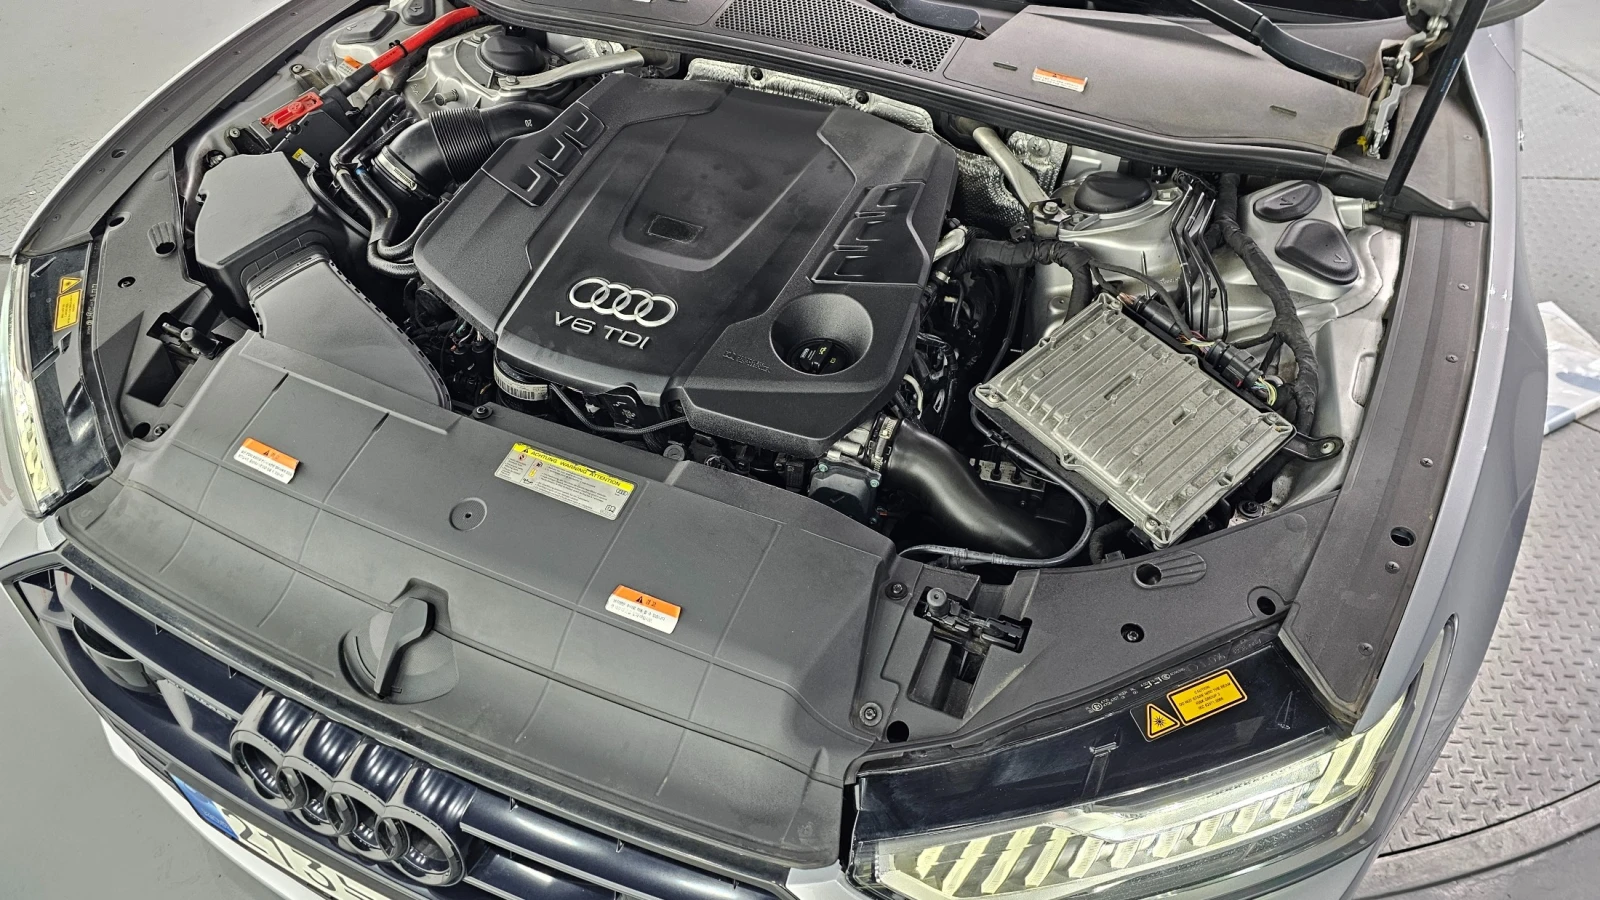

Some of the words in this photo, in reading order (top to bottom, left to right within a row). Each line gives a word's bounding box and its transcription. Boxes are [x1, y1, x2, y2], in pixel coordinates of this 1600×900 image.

[555, 311, 596, 334] V6
[604, 325, 650, 350] TDI
[531, 451, 558, 463] ACHTUNG
[560, 461, 587, 474] WARNING
[589, 471, 621, 486] ATTENTION
